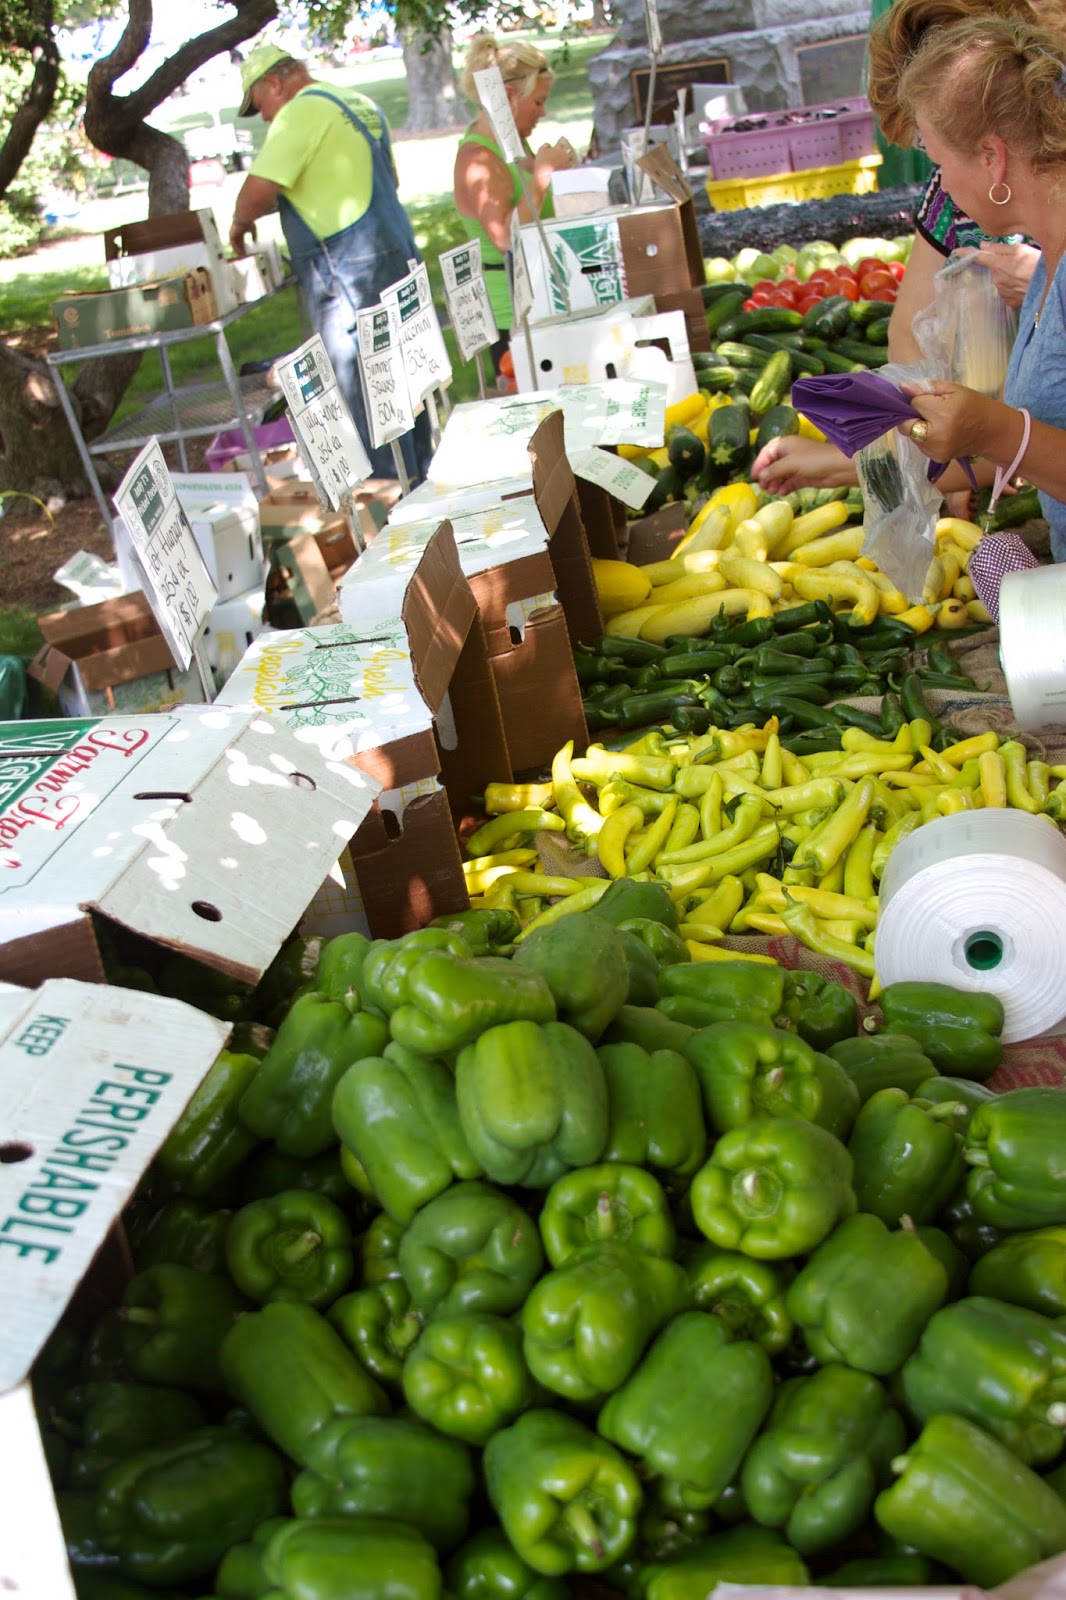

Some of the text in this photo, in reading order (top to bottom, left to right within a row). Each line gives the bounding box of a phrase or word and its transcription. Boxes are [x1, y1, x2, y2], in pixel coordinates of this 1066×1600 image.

[402, 313, 432, 344] ucchini
[361, 650, 408, 700] Fresh
[35, 729, 149, 793] Farm
[16, 1014, 72, 1056] KEEP
[0, 1063, 174, 1265] PERISHABLE
